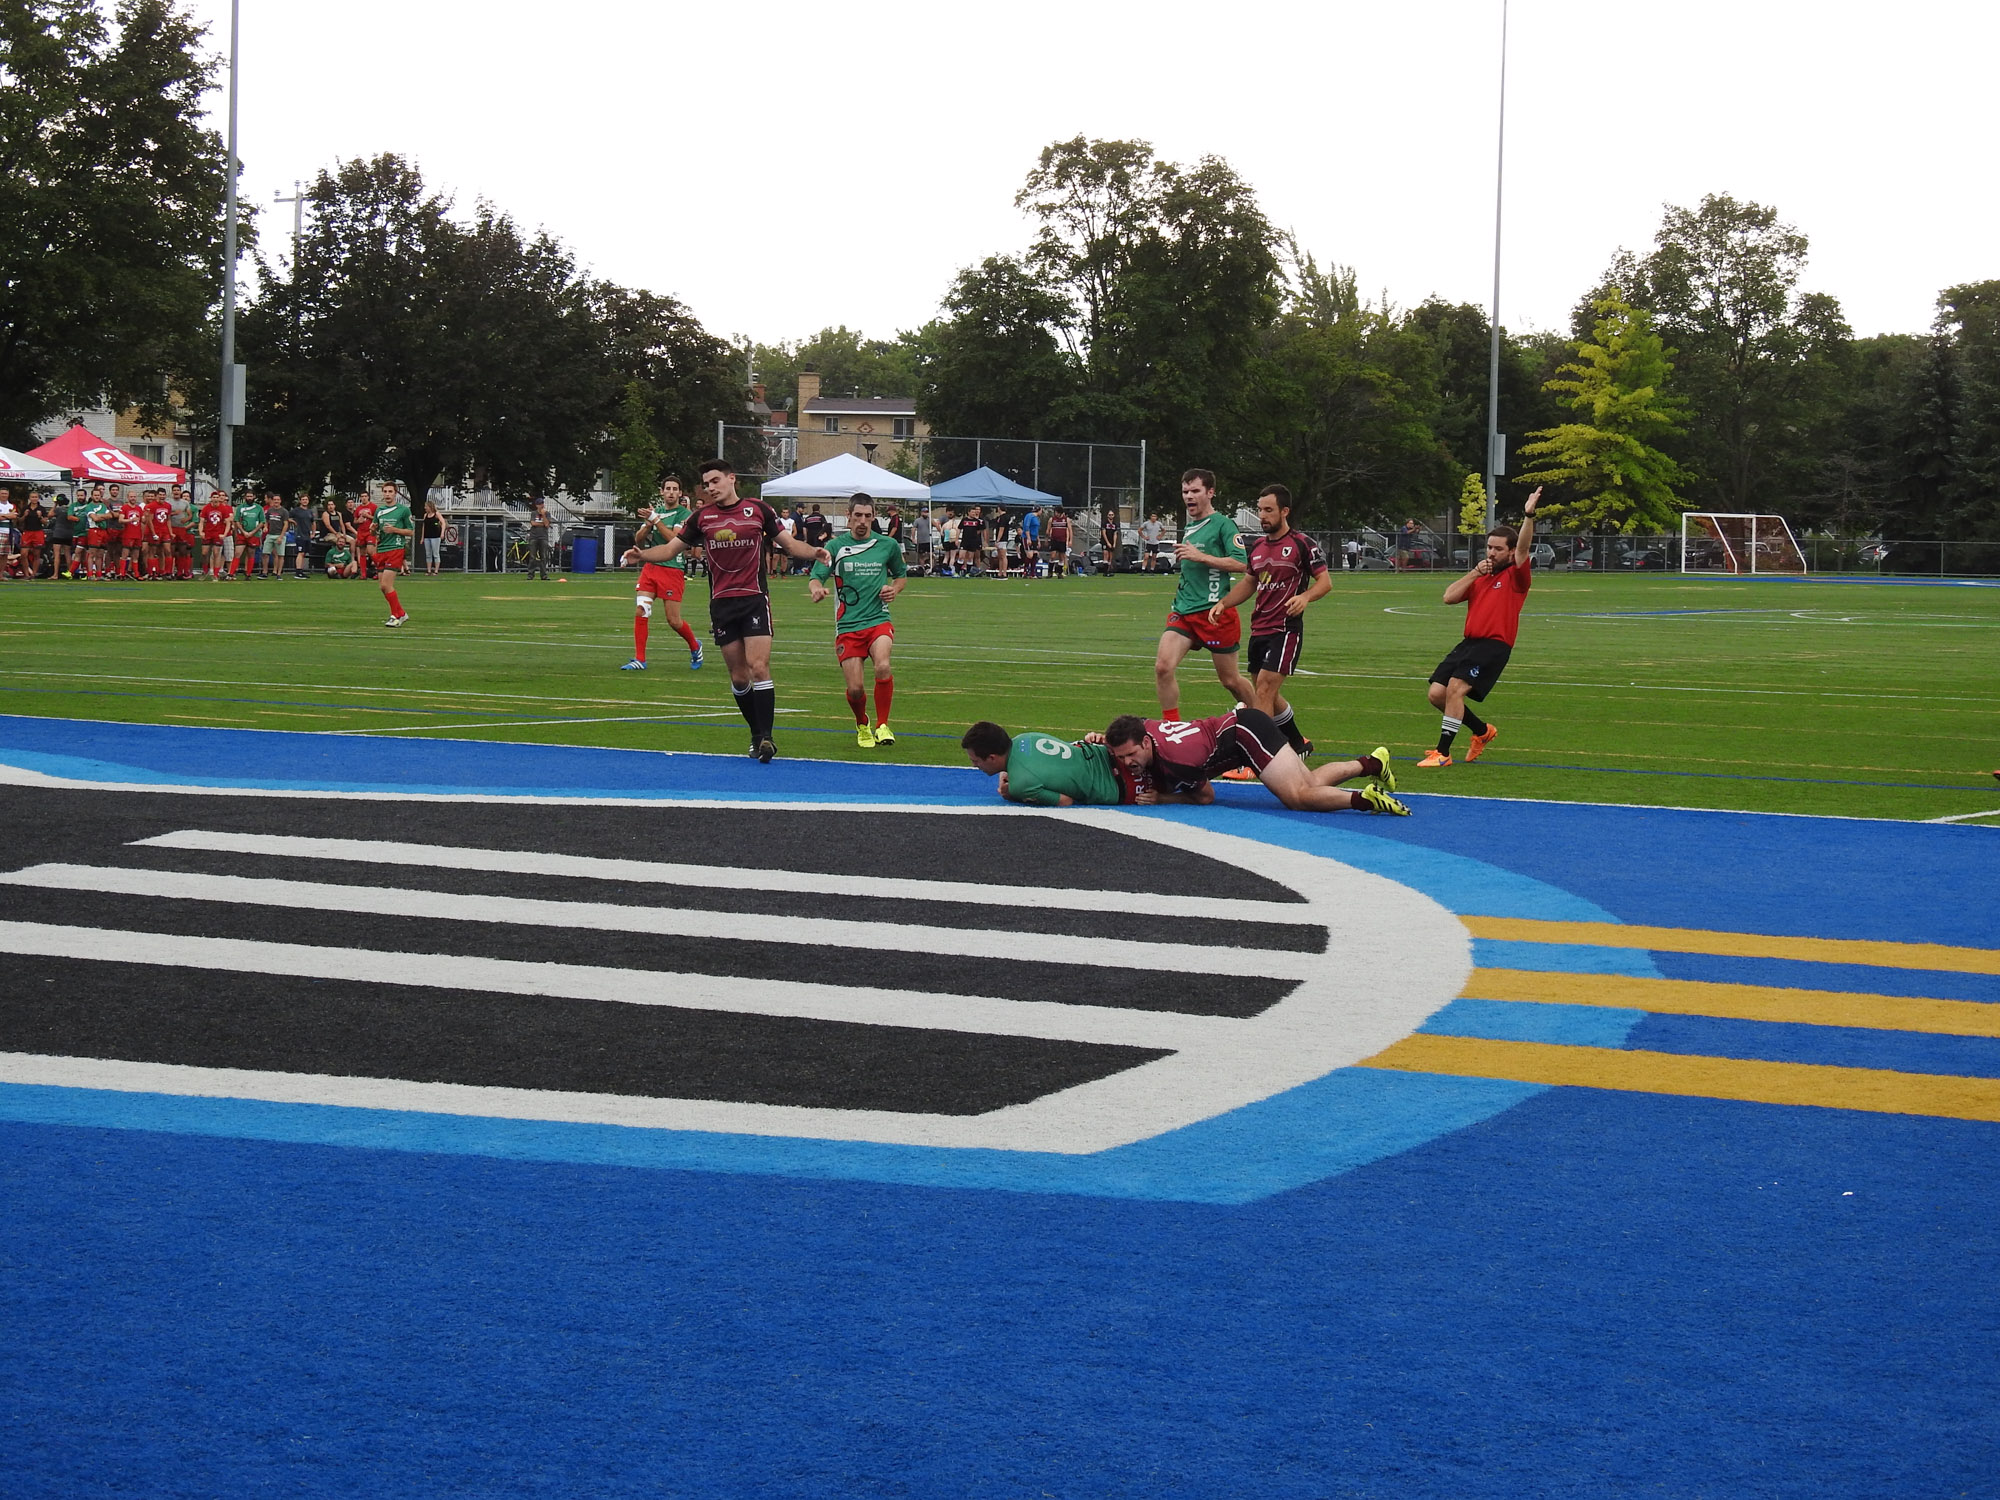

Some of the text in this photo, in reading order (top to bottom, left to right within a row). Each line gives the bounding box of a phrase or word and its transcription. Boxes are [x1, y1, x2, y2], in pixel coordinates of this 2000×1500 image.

[94, 451, 132, 470] B
[710, 540, 754, 549] BRUTOPIA
[1036, 738, 1072, 759] 9
